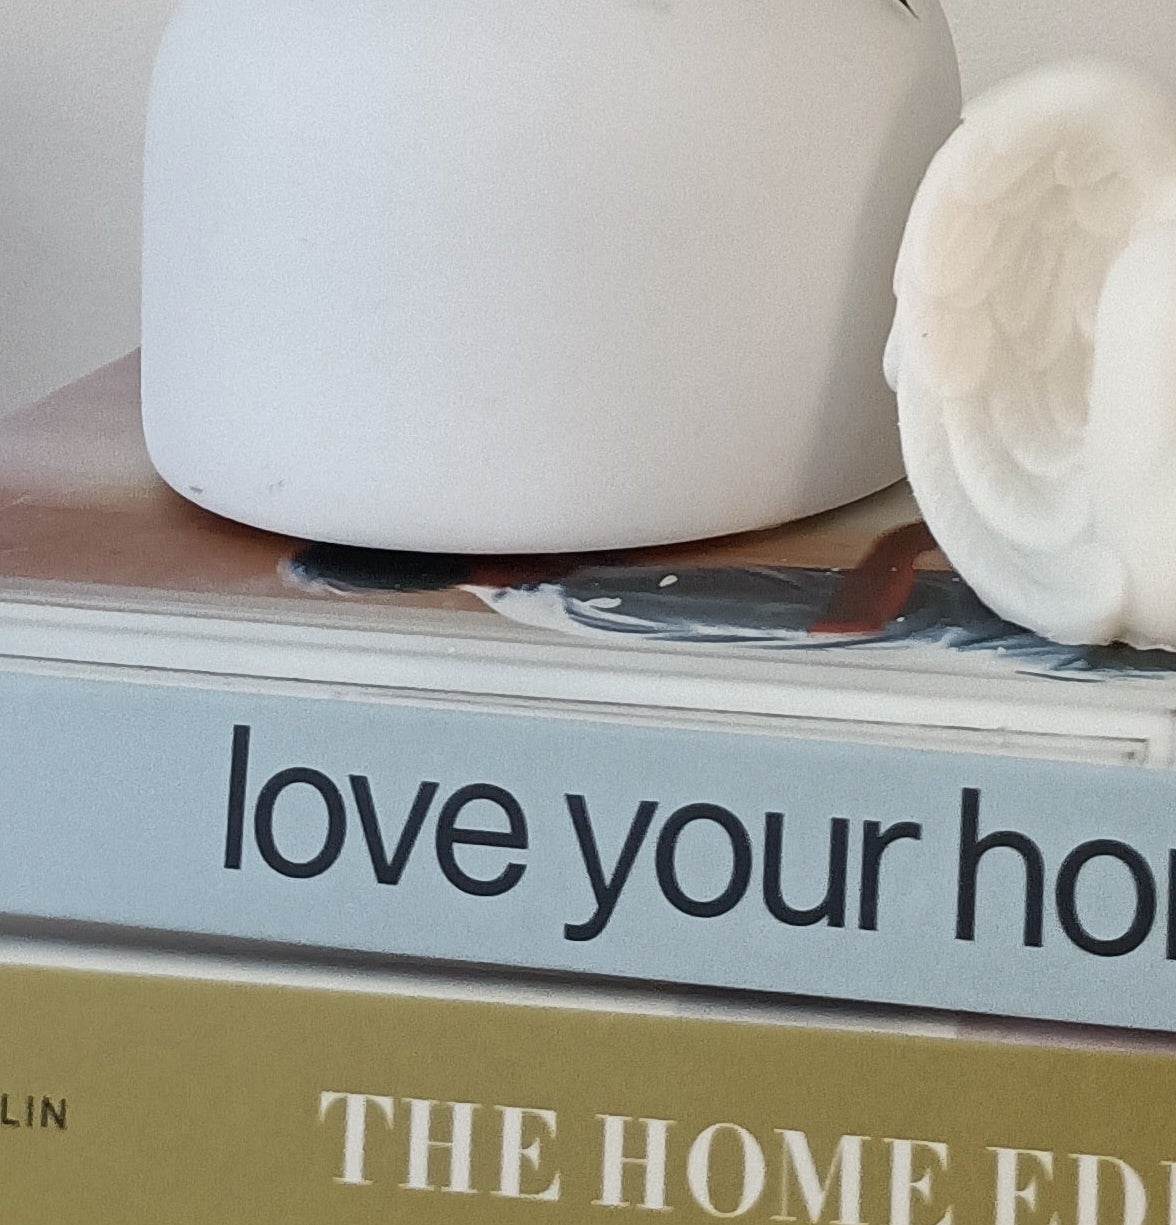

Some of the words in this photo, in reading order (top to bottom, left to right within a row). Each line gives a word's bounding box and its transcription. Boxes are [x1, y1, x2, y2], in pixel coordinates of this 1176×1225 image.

[223, 724, 529, 897] love
[563, 793, 922, 942] your
[319, 1090, 561, 1202] THE
[591, 1113, 954, 1225] HOME
